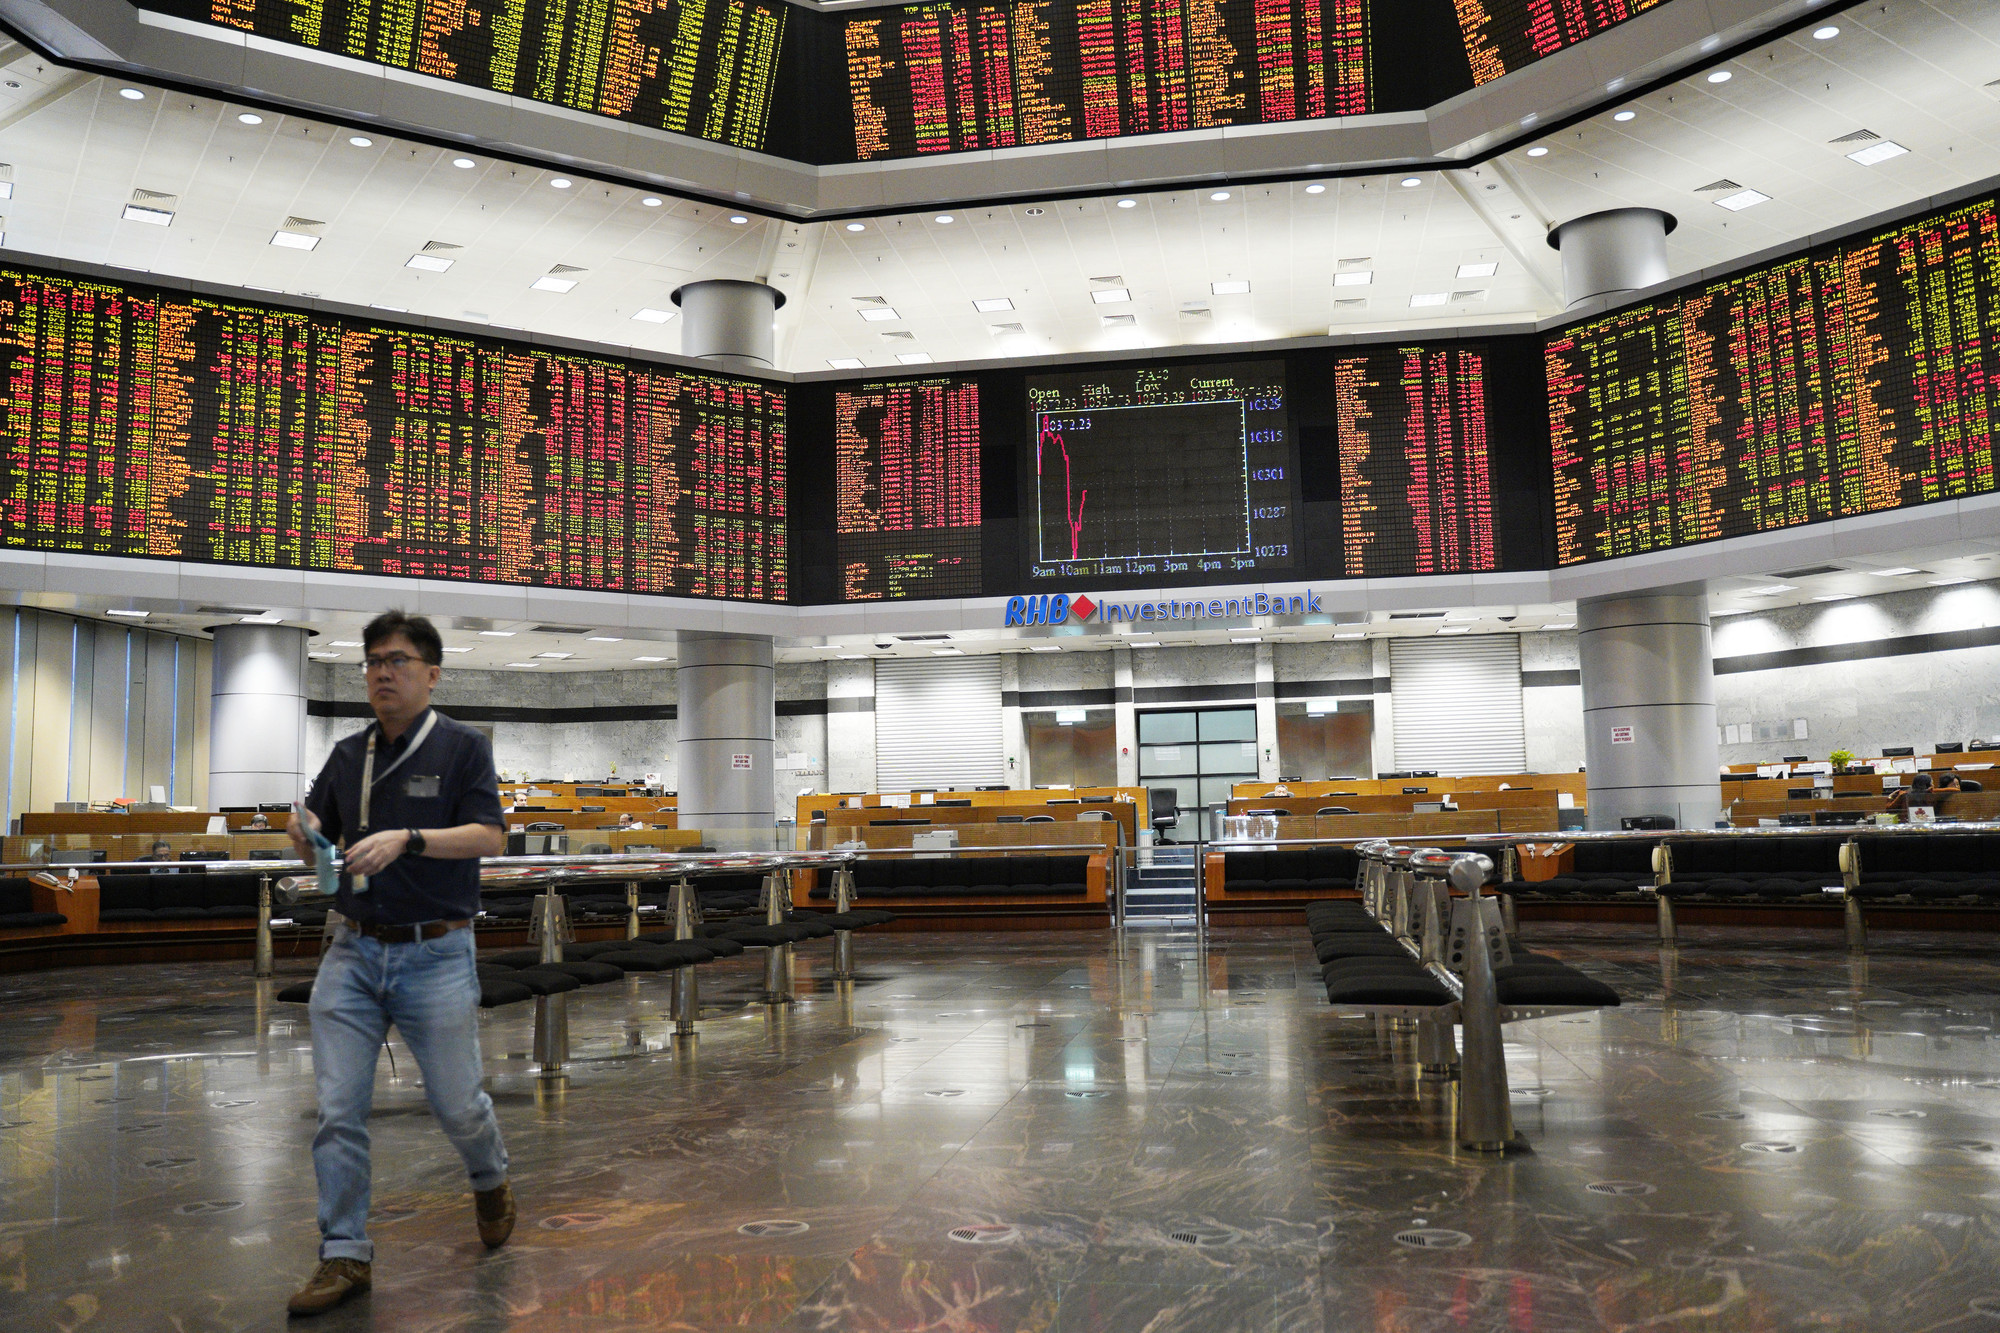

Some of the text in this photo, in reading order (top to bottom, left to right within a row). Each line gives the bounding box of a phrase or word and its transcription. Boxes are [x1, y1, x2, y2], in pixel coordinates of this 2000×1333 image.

[904, 7, 918, 15] TOP
[849, 20, 882, 29] Counter
[1847, 243, 1883, 259] Counter
[78, 281, 124, 294] COUNTERS
[1029, 377, 1234, 403] Open High Low Current
[1253, 506, 1286, 519] 10287
[1255, 544, 1288, 557] 10273
[1032, 557, 1256, 578] 9am 10am 11am 12pm 3pm 4pm 5pm
[1004, 594, 1070, 627] RHB
